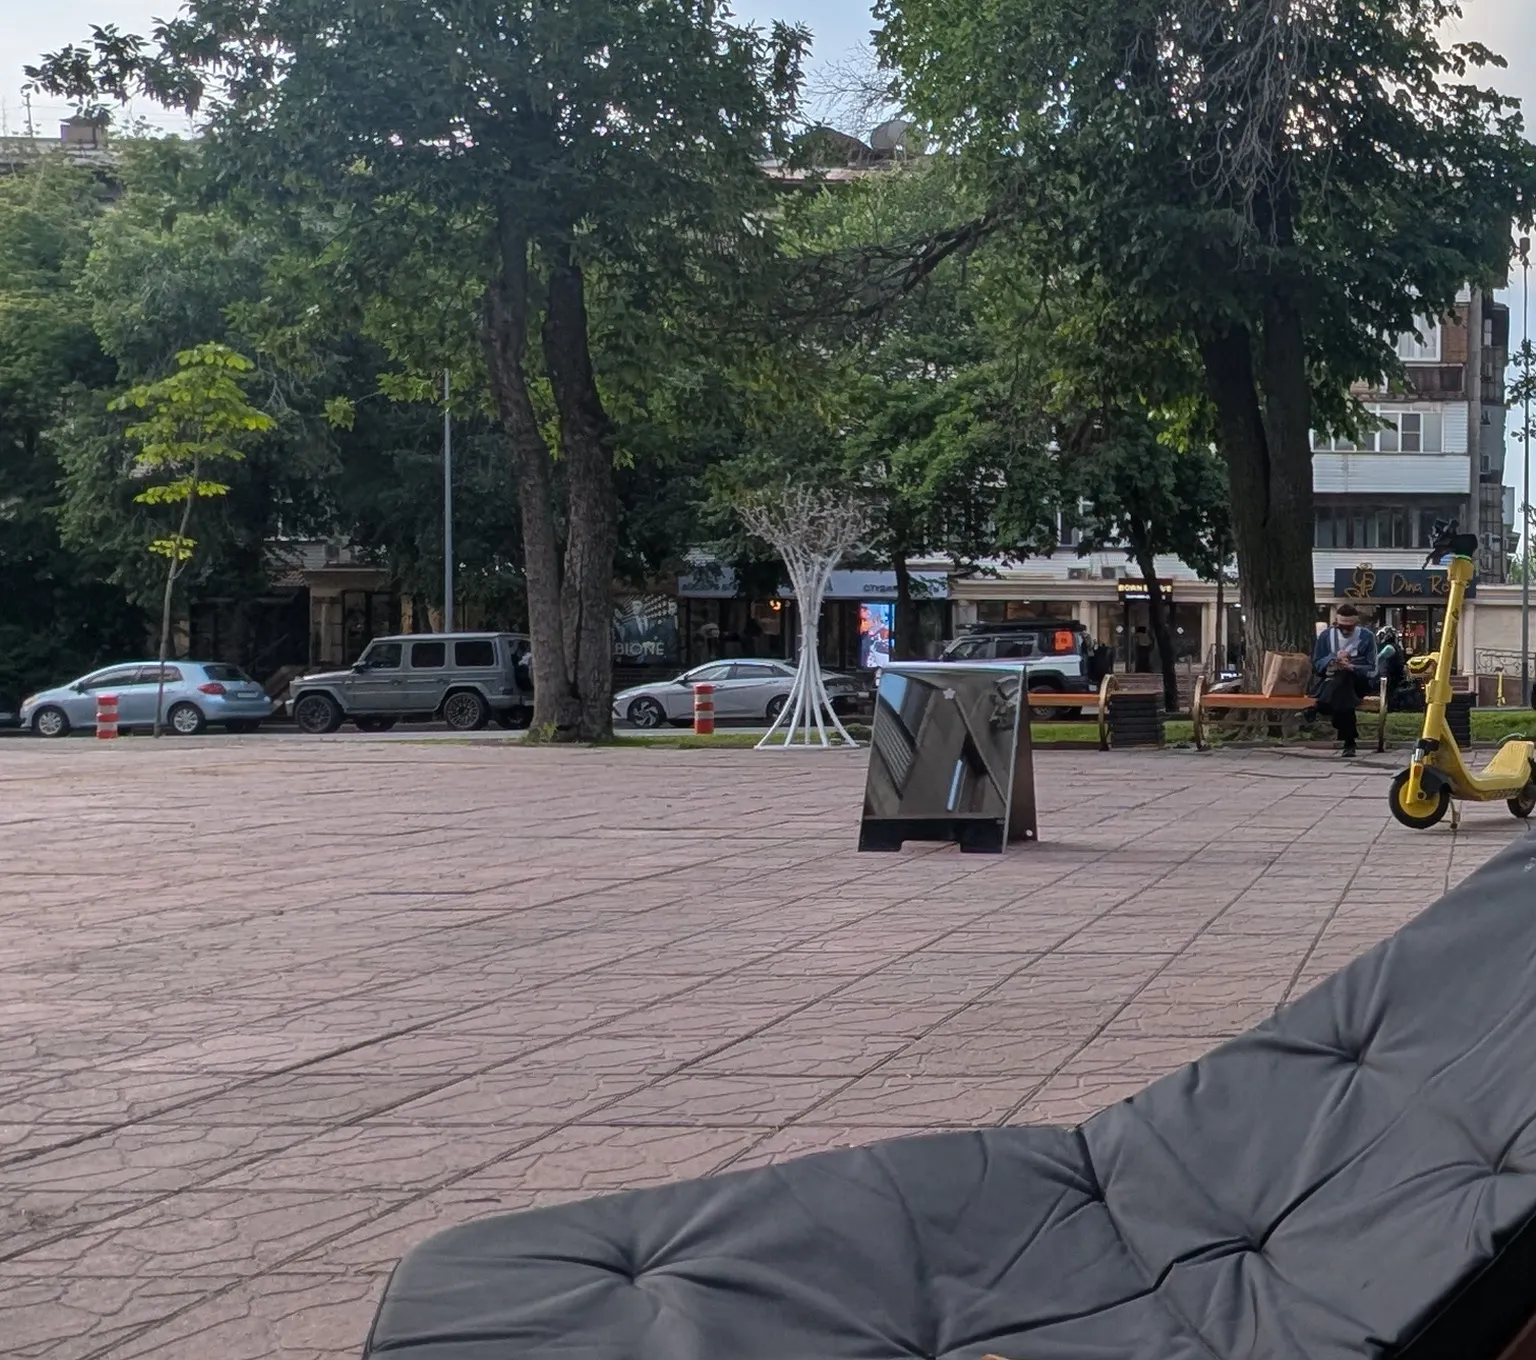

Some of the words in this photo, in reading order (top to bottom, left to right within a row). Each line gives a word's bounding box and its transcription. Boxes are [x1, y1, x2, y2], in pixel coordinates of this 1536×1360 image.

[1118, 583, 1142, 592] BORN
[1143, 583, 1172, 593] LVE
[1427, 574, 1451, 595] Ro
[613, 641, 665, 656] BIONE
